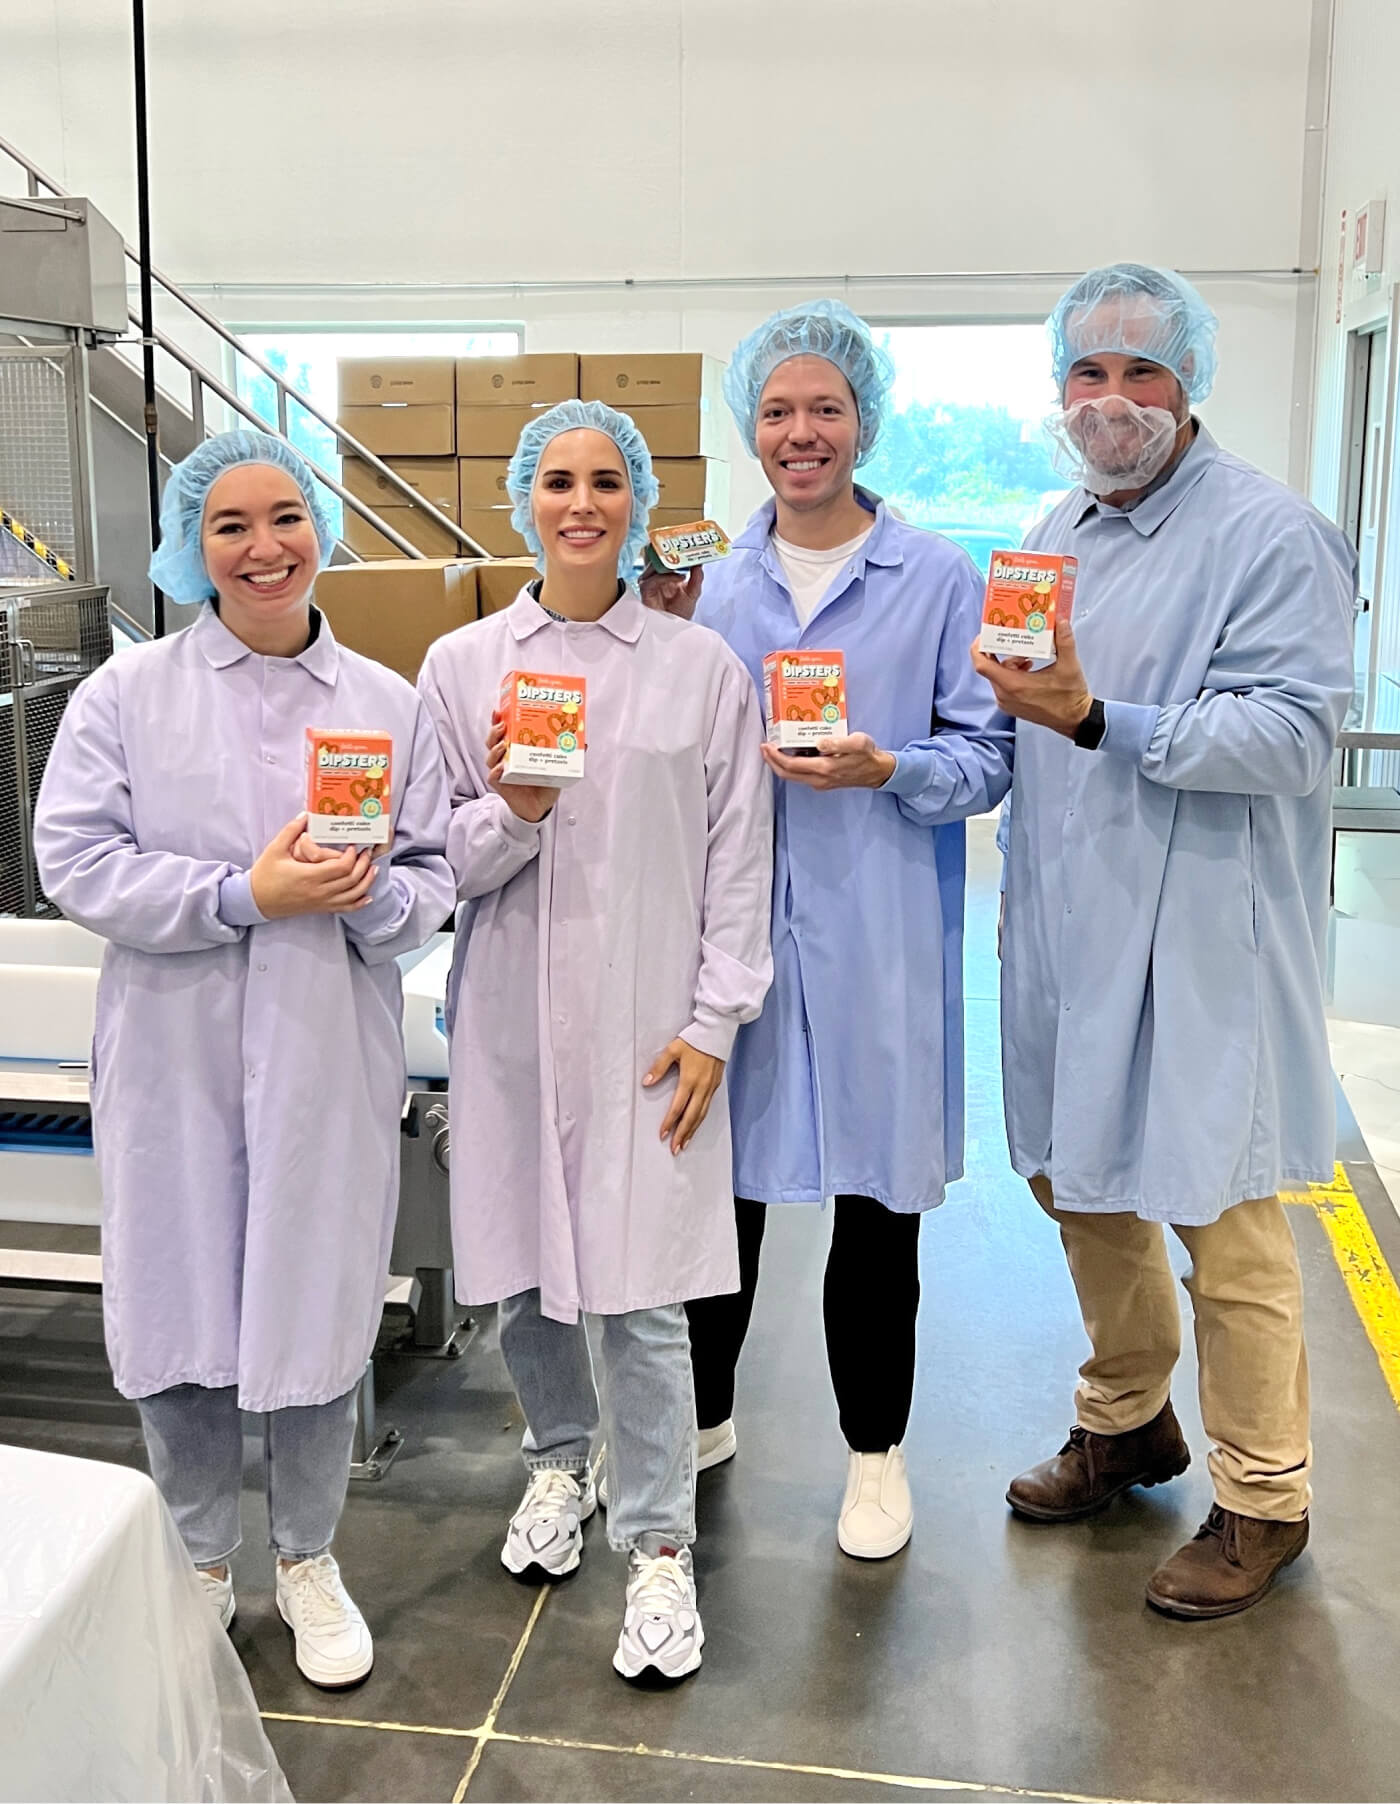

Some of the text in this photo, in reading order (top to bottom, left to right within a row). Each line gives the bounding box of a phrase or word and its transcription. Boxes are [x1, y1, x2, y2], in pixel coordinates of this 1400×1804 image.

[661, 529, 721, 553] DIPSTERS
[993, 566, 1056, 584] DIPSTERS
[783, 665, 841, 678] DIPSTERS
[519, 687, 582, 704] DIPSTERS
[319, 754, 388, 768] DIPSTERS
